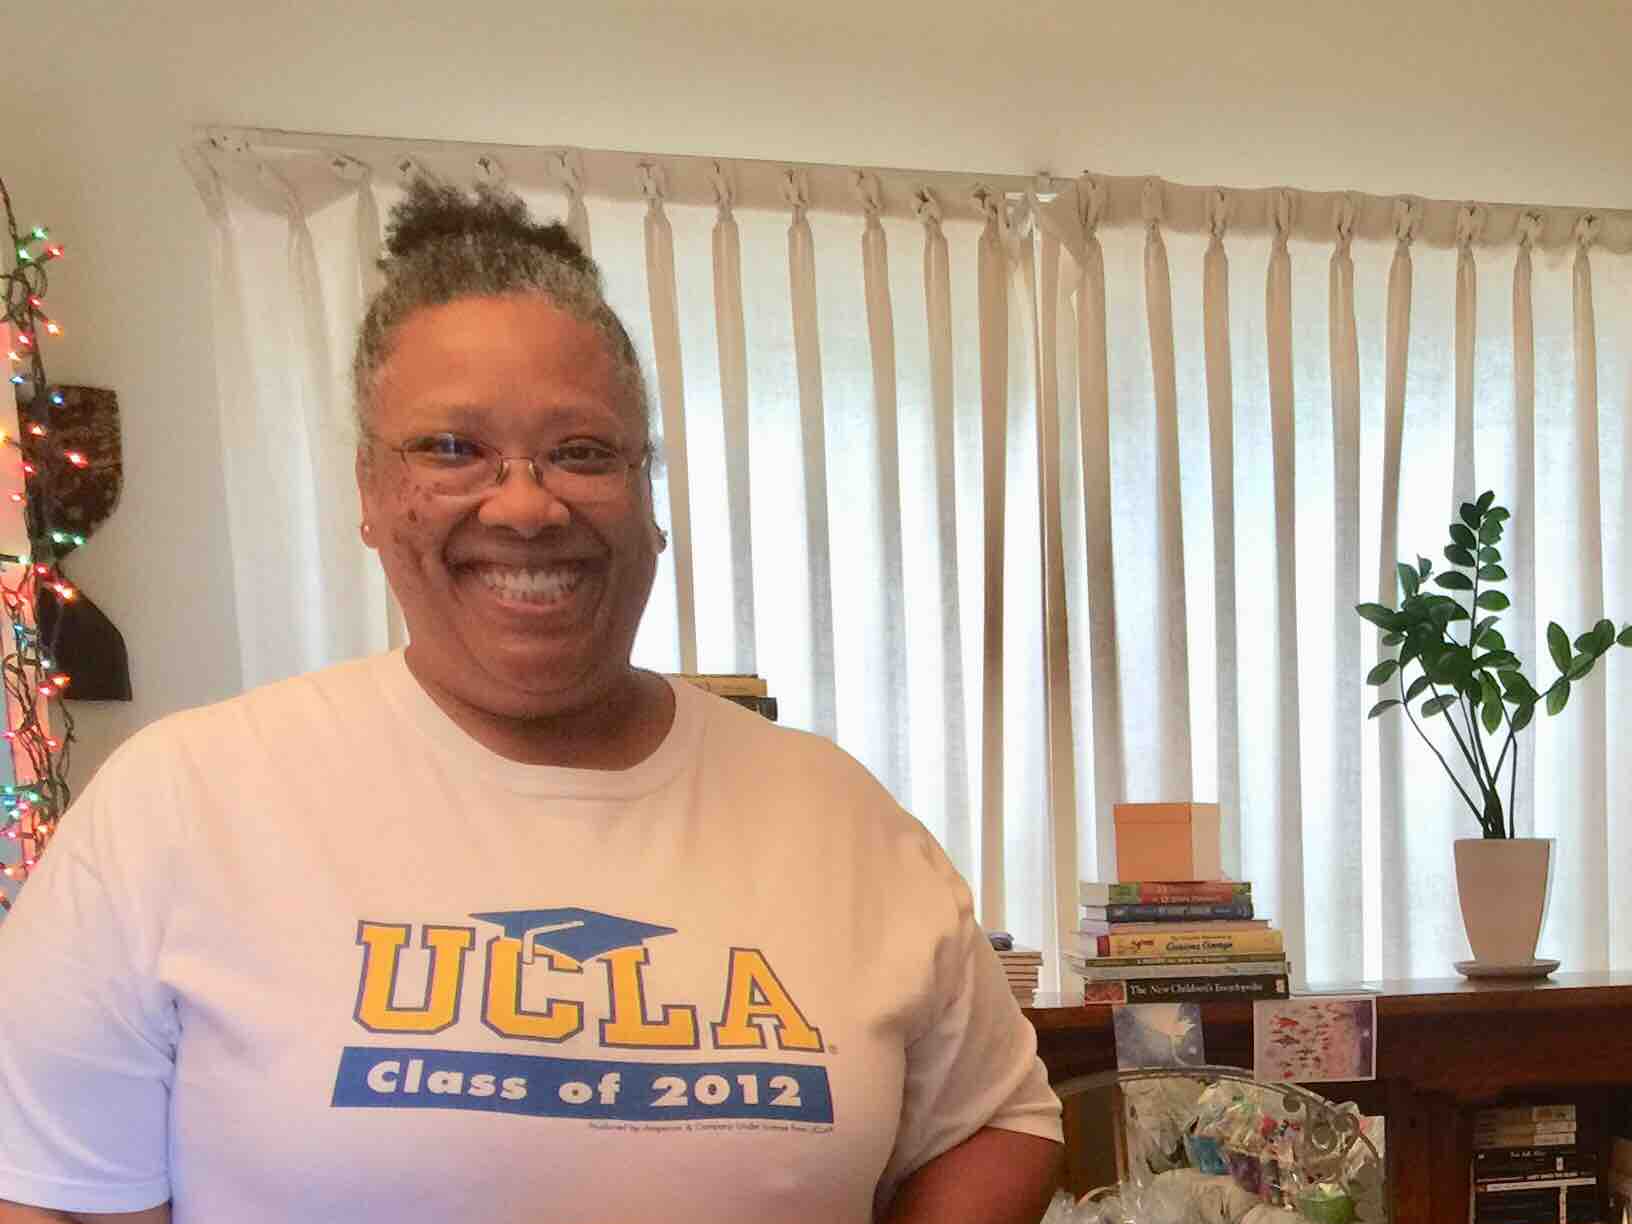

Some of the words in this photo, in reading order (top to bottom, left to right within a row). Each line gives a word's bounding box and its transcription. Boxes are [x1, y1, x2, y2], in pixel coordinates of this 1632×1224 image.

[353, 919, 825, 1054] UCLA
[1131, 984, 1147, 996] The
[1151, 984, 1168, 995] New
[366, 1058, 528, 1102] Class
[558, 1072, 620, 1106] of
[651, 1073, 802, 1108] 2012
